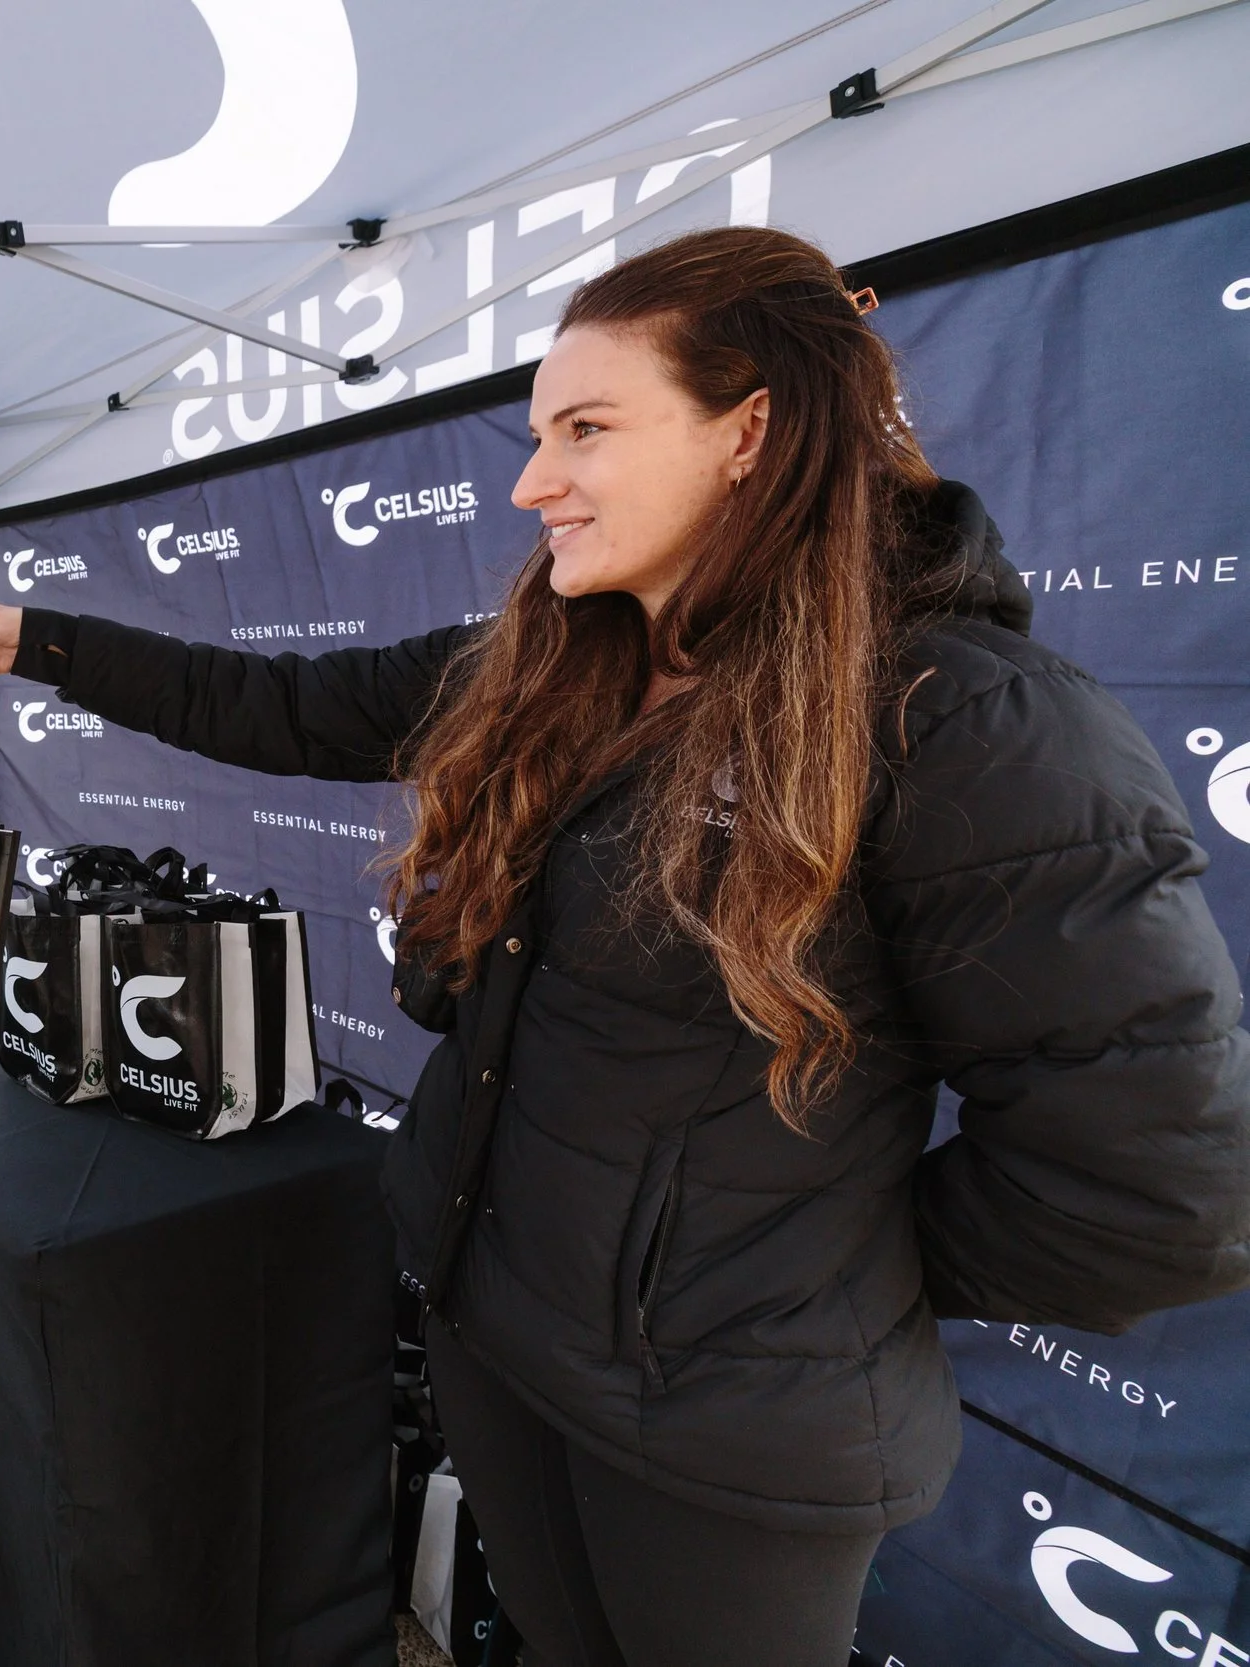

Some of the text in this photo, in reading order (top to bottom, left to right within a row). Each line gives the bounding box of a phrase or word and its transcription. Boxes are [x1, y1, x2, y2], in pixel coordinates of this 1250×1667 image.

[436, 510, 476, 526] LIVE FIT
[230, 549, 240, 558] FIT
[68, 571, 88, 581] LIVE FIT
[231, 620, 366, 640] ESSENTIAL ENERGY
[79, 792, 186, 812] ESSENTIAL ENERGY
[253, 810, 386, 842] ESSENTIAL ENERGY
[331, 1010, 385, 1041] ENERGY
[164, 1097, 198, 1112] LIVE FIT
[1009, 1323, 1177, 1418] ENERGY
